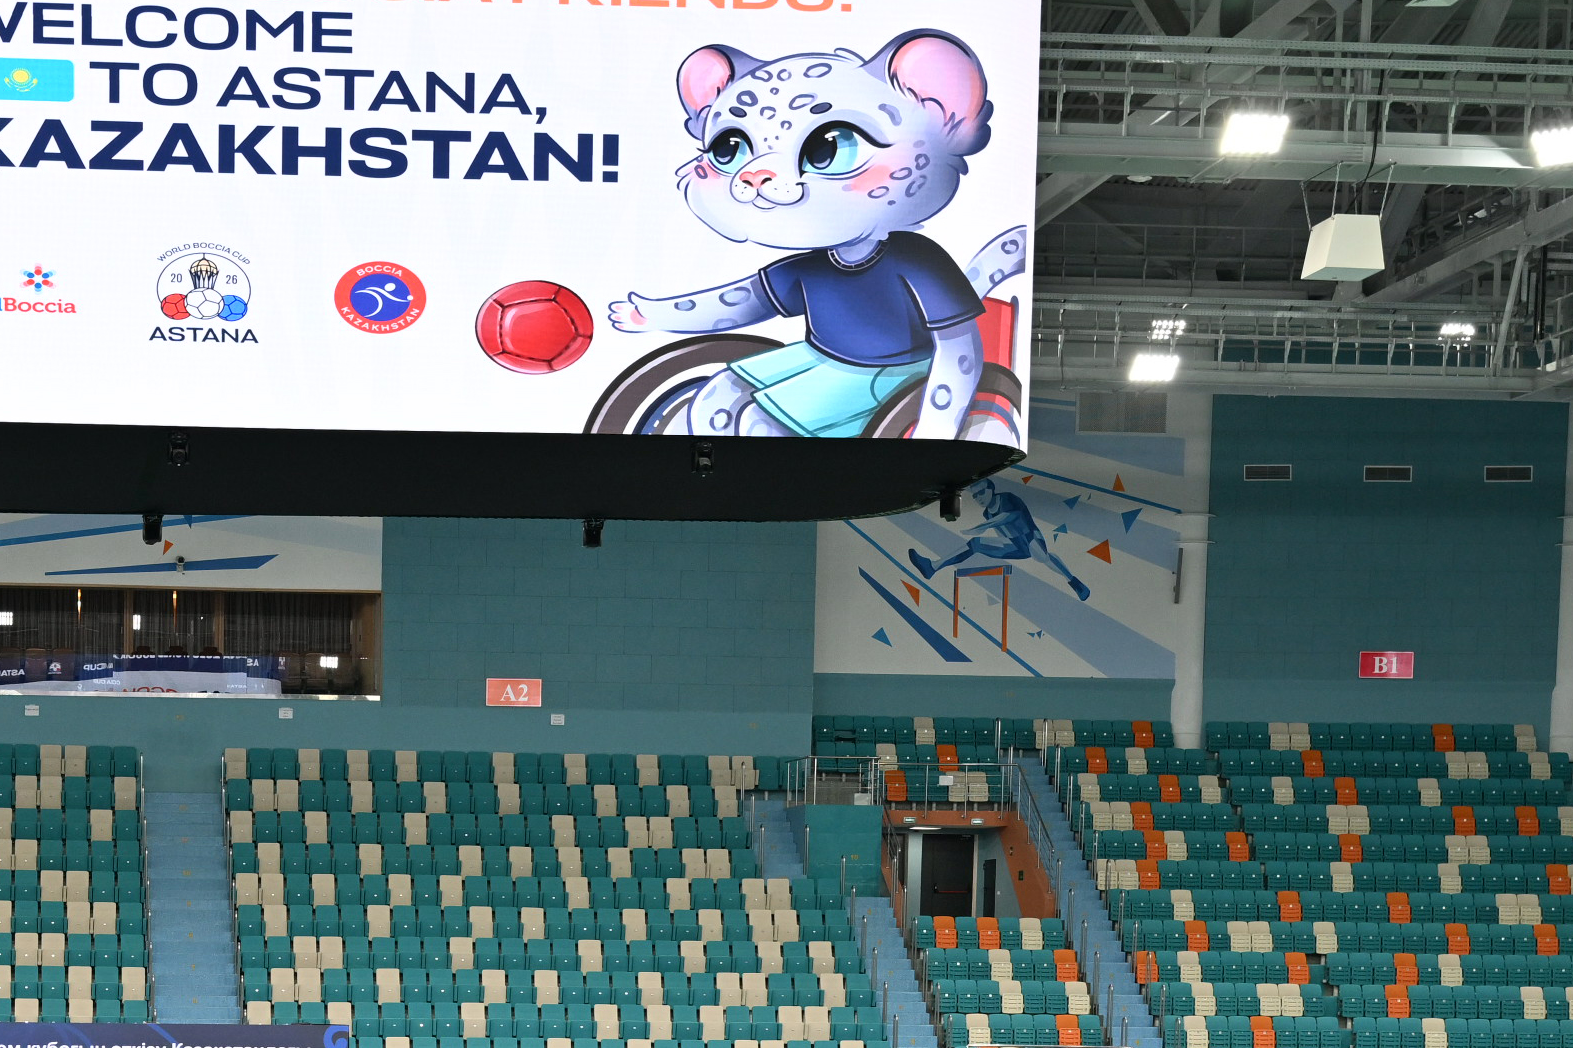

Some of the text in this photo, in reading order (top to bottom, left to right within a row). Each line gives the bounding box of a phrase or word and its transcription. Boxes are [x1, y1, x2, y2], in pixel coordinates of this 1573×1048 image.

[89, 60, 548, 125] TO ASTANA,
[156, 242, 251, 266] WORLD BOCCIA CUP
[170, 272, 238, 286] 20 26
[356, 264, 403, 277] BOCCIA
[340, 306, 420, 332] KAZAKHSTAN
[149, 326, 259, 344] ASTANA
[1373, 656, 1398, 674] B1
[500, 683, 529, 702] A2
